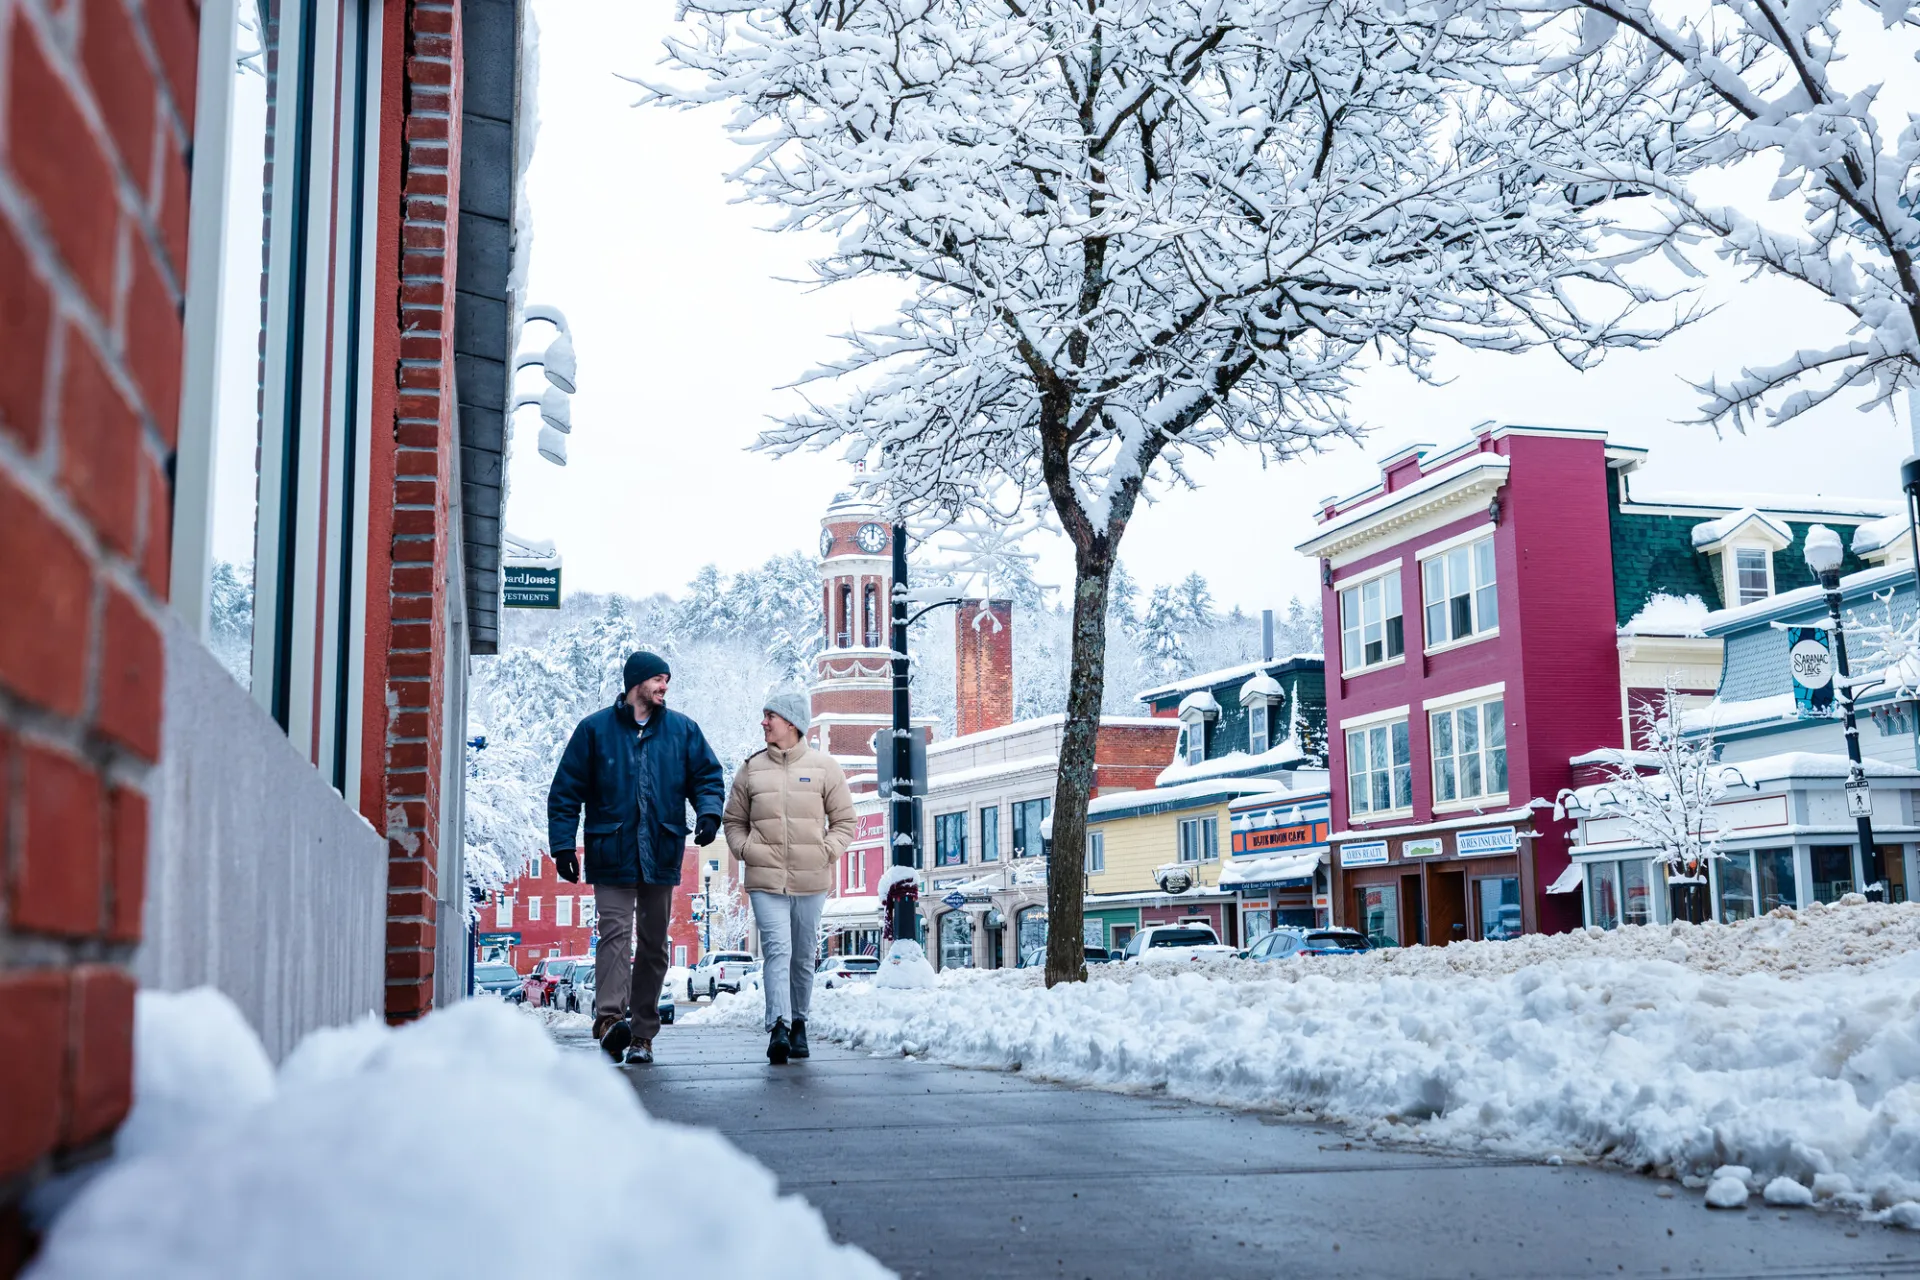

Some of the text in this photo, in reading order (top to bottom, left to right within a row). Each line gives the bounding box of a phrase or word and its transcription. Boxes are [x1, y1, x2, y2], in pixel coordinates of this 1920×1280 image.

[524, 573, 556, 584] Jones
[503, 592, 549, 601] VESTMENTS
[1794, 653, 1828, 672] SARANAC
[1804, 663, 1821, 675] LAKE
[1460, 834, 1513, 849] AYRES INSURANCE
[1346, 847, 1382, 860] AYRES REALTY
